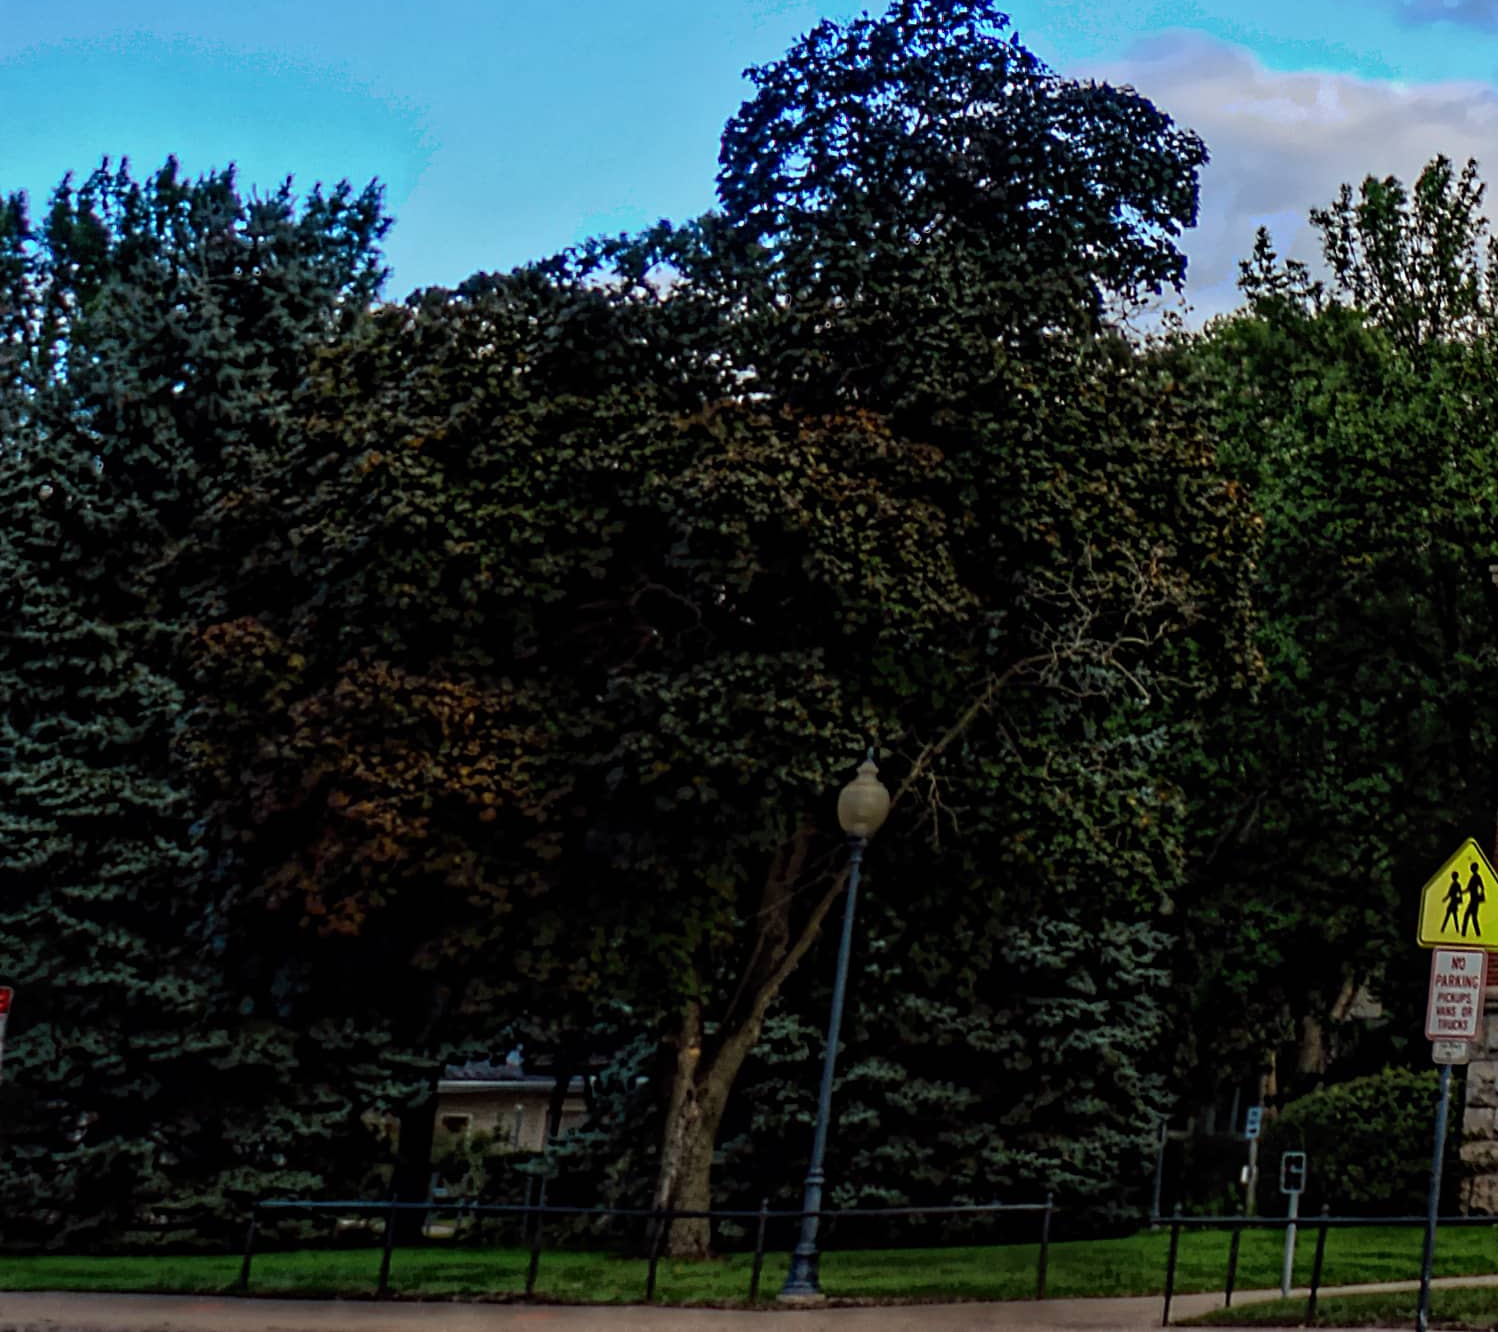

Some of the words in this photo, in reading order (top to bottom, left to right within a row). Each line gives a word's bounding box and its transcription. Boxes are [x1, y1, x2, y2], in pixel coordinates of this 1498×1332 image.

[1451, 957, 1466, 970] NO
[1436, 974, 1480, 989] PARKING
[1462, 1006, 1473, 1016] OR
[1438, 1019, 1468, 1030] TRUCKS
